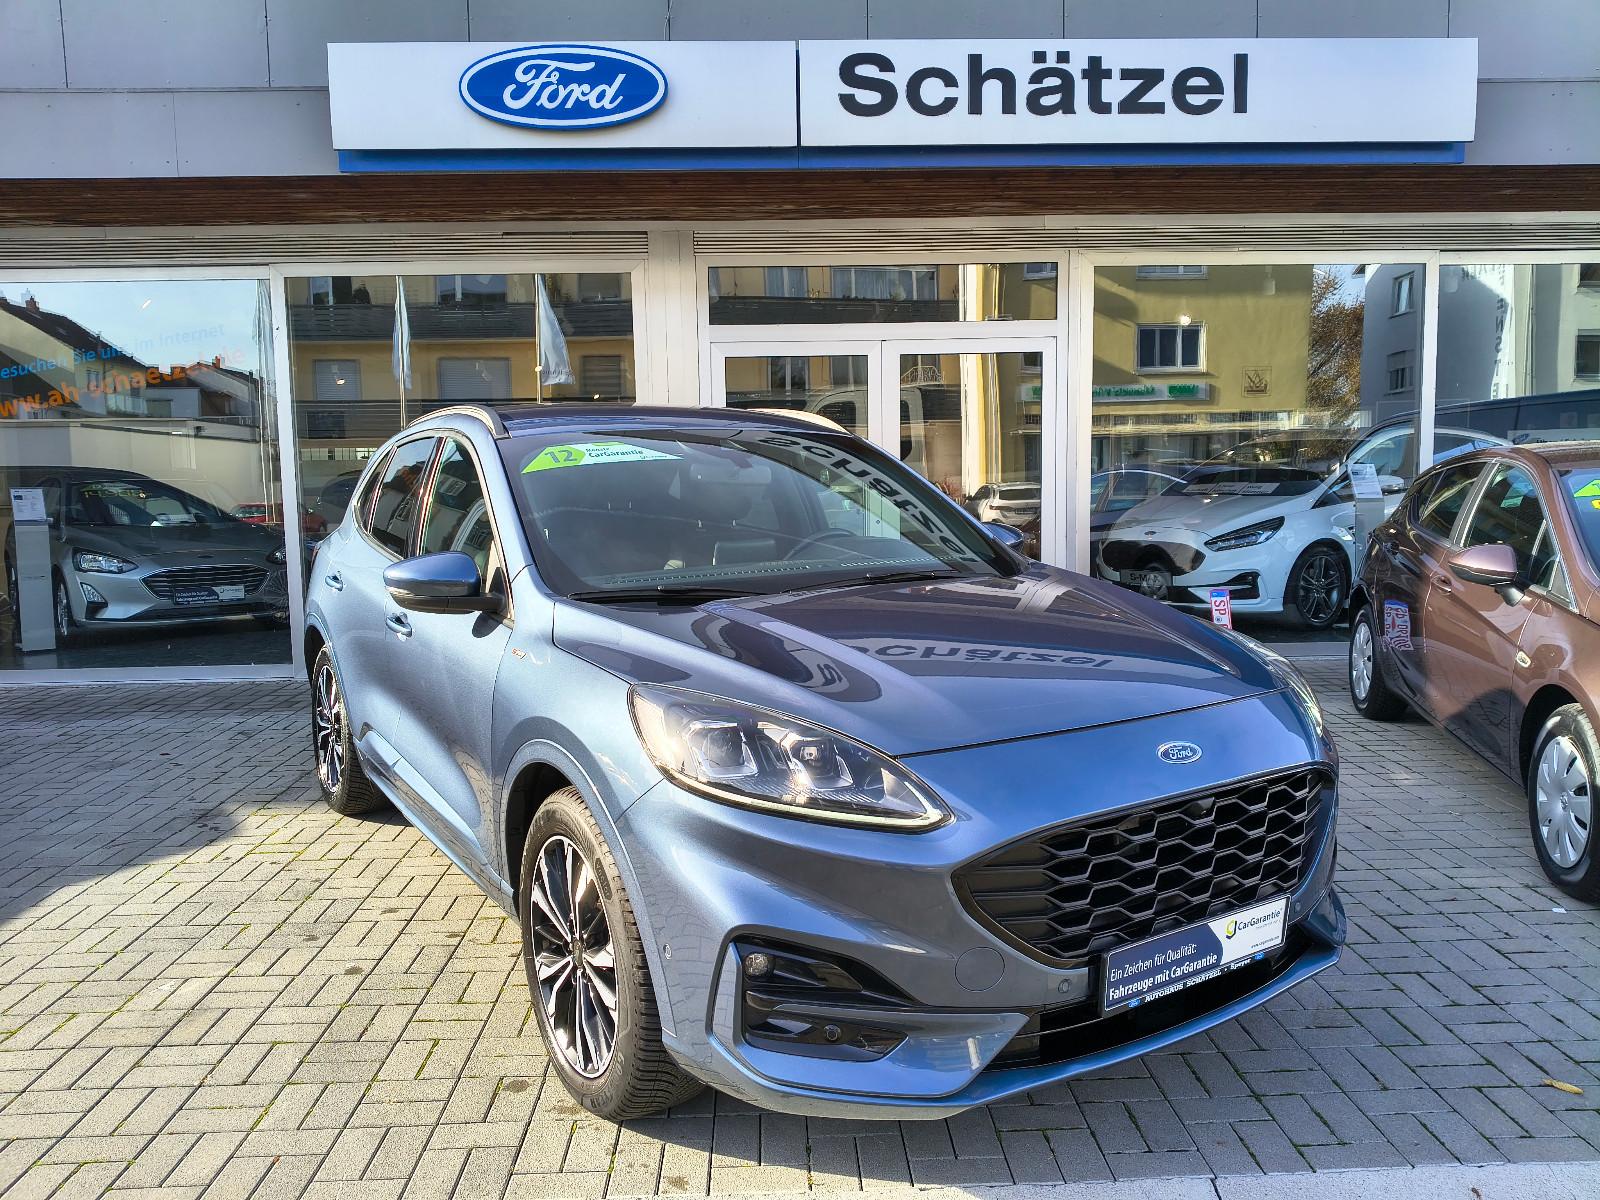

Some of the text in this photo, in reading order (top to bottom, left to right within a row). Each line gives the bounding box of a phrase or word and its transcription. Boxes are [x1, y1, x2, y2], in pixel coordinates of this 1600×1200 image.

[502, 59, 627, 111] Ford
[838, 50, 1249, 117] Schätzel
[0, 356, 68, 380] esuchen
[159, 323, 226, 346] Internet
[544, 449, 578, 464] 12
[588, 449, 643, 458] CarGarantie
[1213, 599, 1226, 617] SP
[1168, 745, 1194, 760] Ford
[1237, 909, 1281, 931] CarGarantie
[1110, 943, 1197, 982] Ein Zeichen für Qualität:
[1109, 952, 1218, 1001] Fahrzeuge mit CarGarantie
[1144, 983, 1184, 1003] AUTOHAUS
